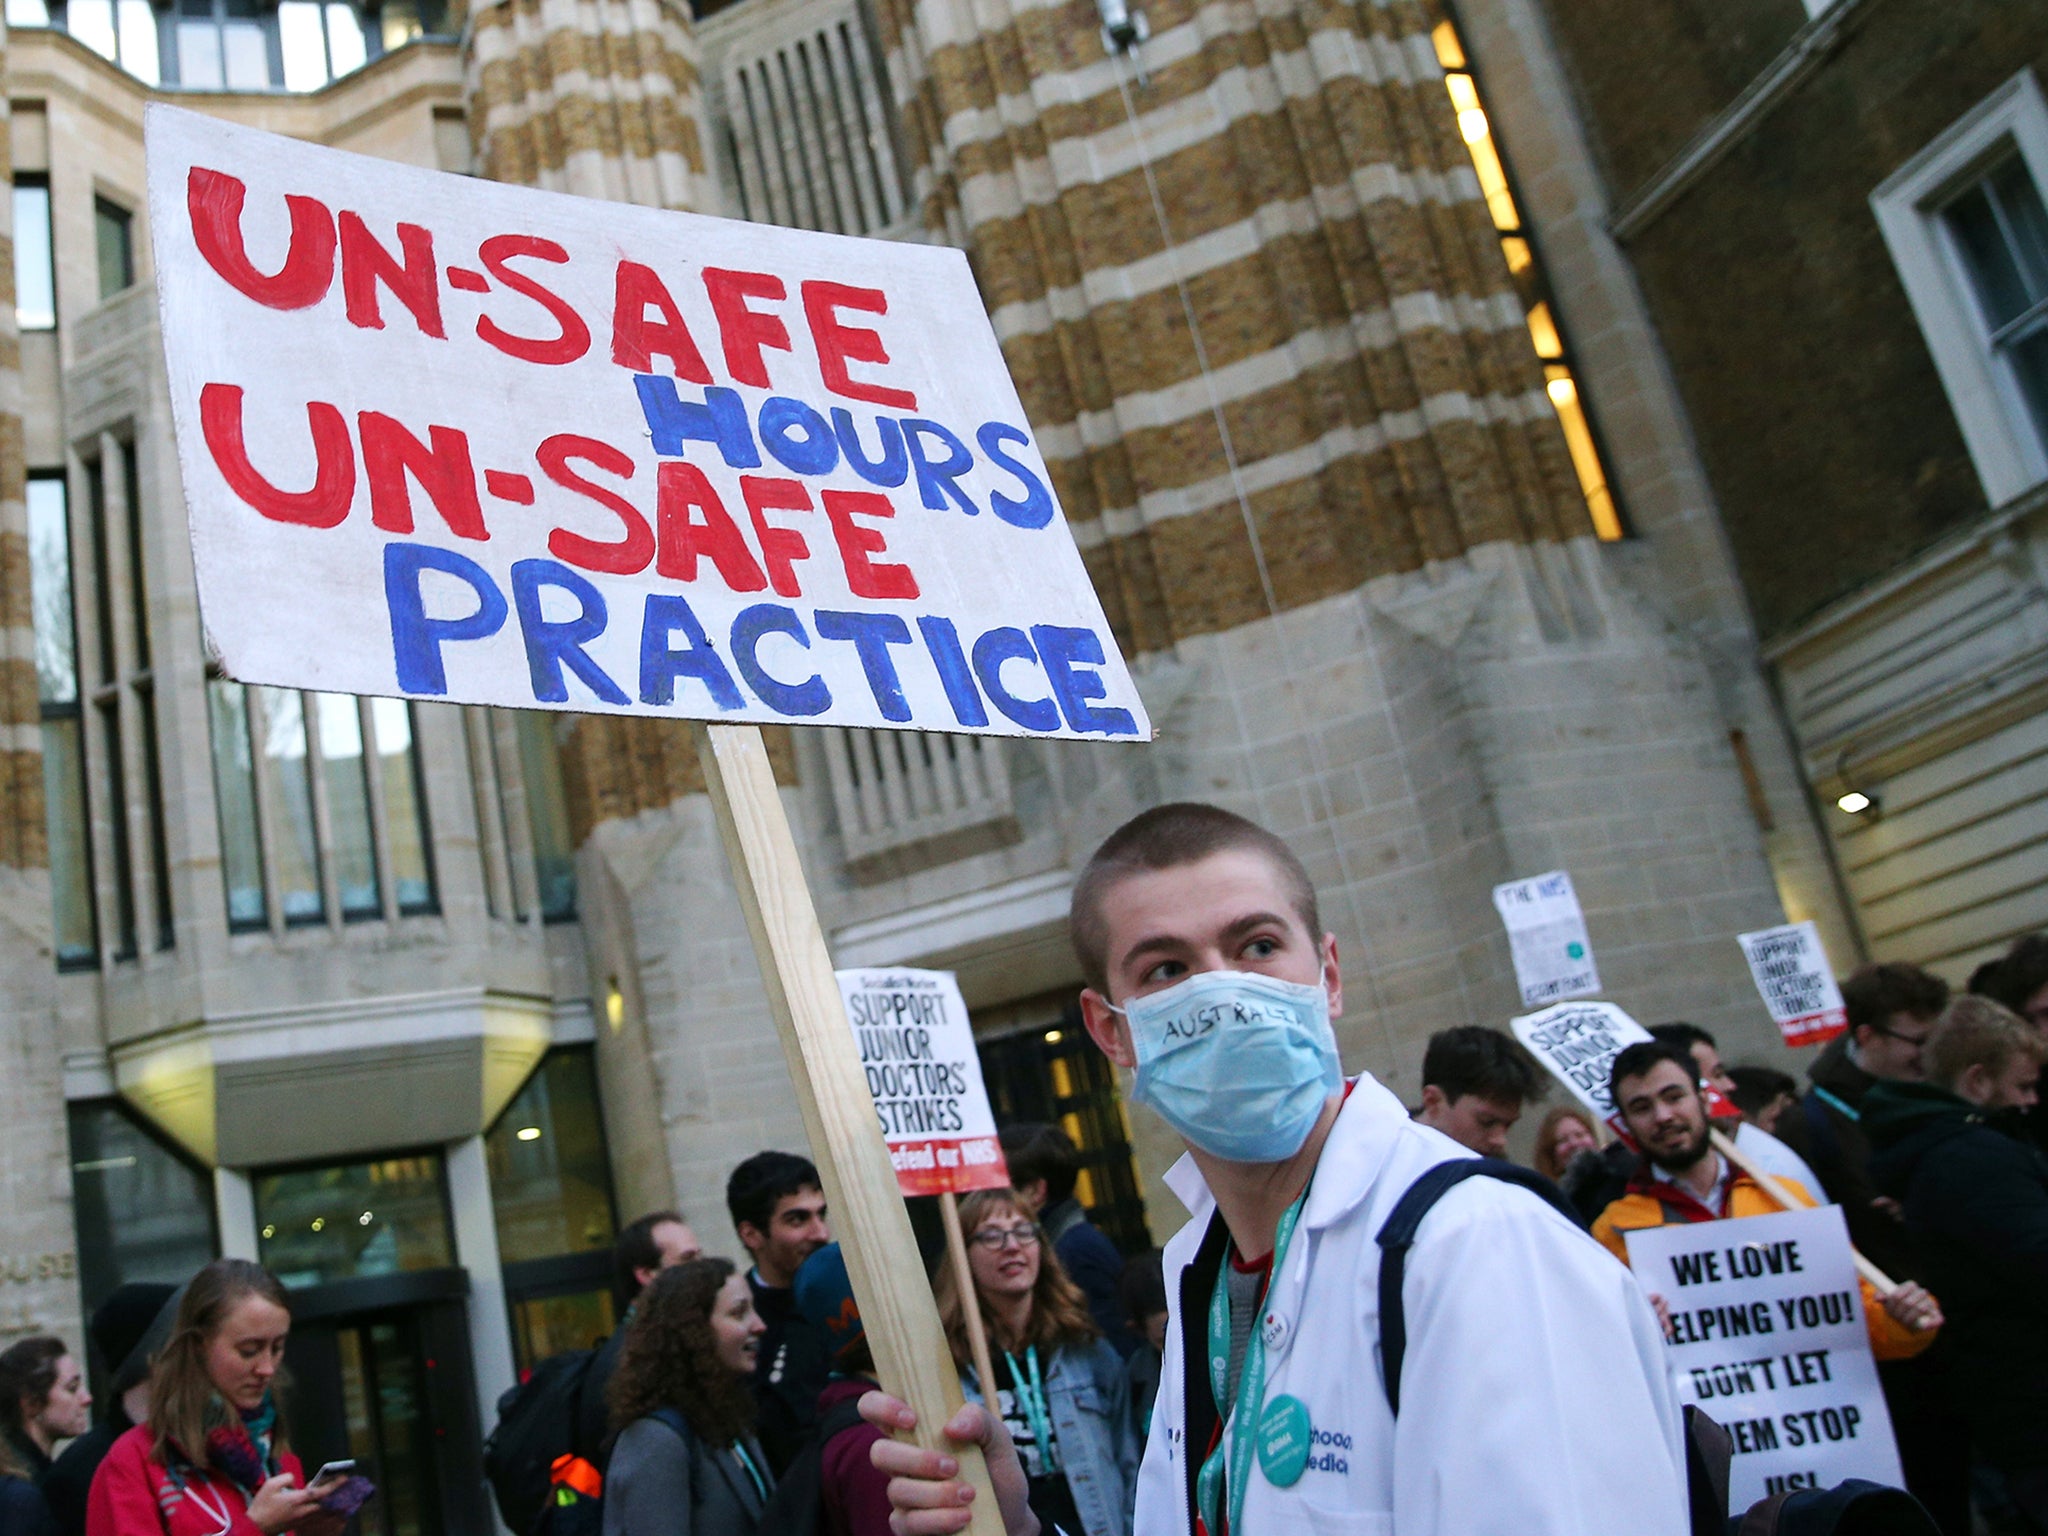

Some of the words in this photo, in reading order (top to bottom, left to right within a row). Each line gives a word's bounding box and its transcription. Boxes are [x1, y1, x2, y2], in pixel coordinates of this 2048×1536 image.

[188, 167, 917, 411] UN-SAFE
[634, 374, 1053, 530] HOURS
[200, 383, 920, 600] UN-SAFE
[384, 543, 1138, 734] PRACTICE
[850, 994, 948, 1025] SUPPORT
[860, 1029, 933, 1062] JUNIOR
[875, 1099, 963, 1134] STRIKES
[891, 1142, 936, 1171] efend
[1671, 1252, 1721, 1286] WE
[1726, 1241, 1802, 1279] LOVE
[1666, 1302, 1774, 1345] ELPING
[1778, 1291, 1855, 1330] YOU!
[1690, 1357, 1775, 1399] DON'T
[1782, 1349, 1832, 1386] LET
[1783, 1405, 1861, 1447] STOP
